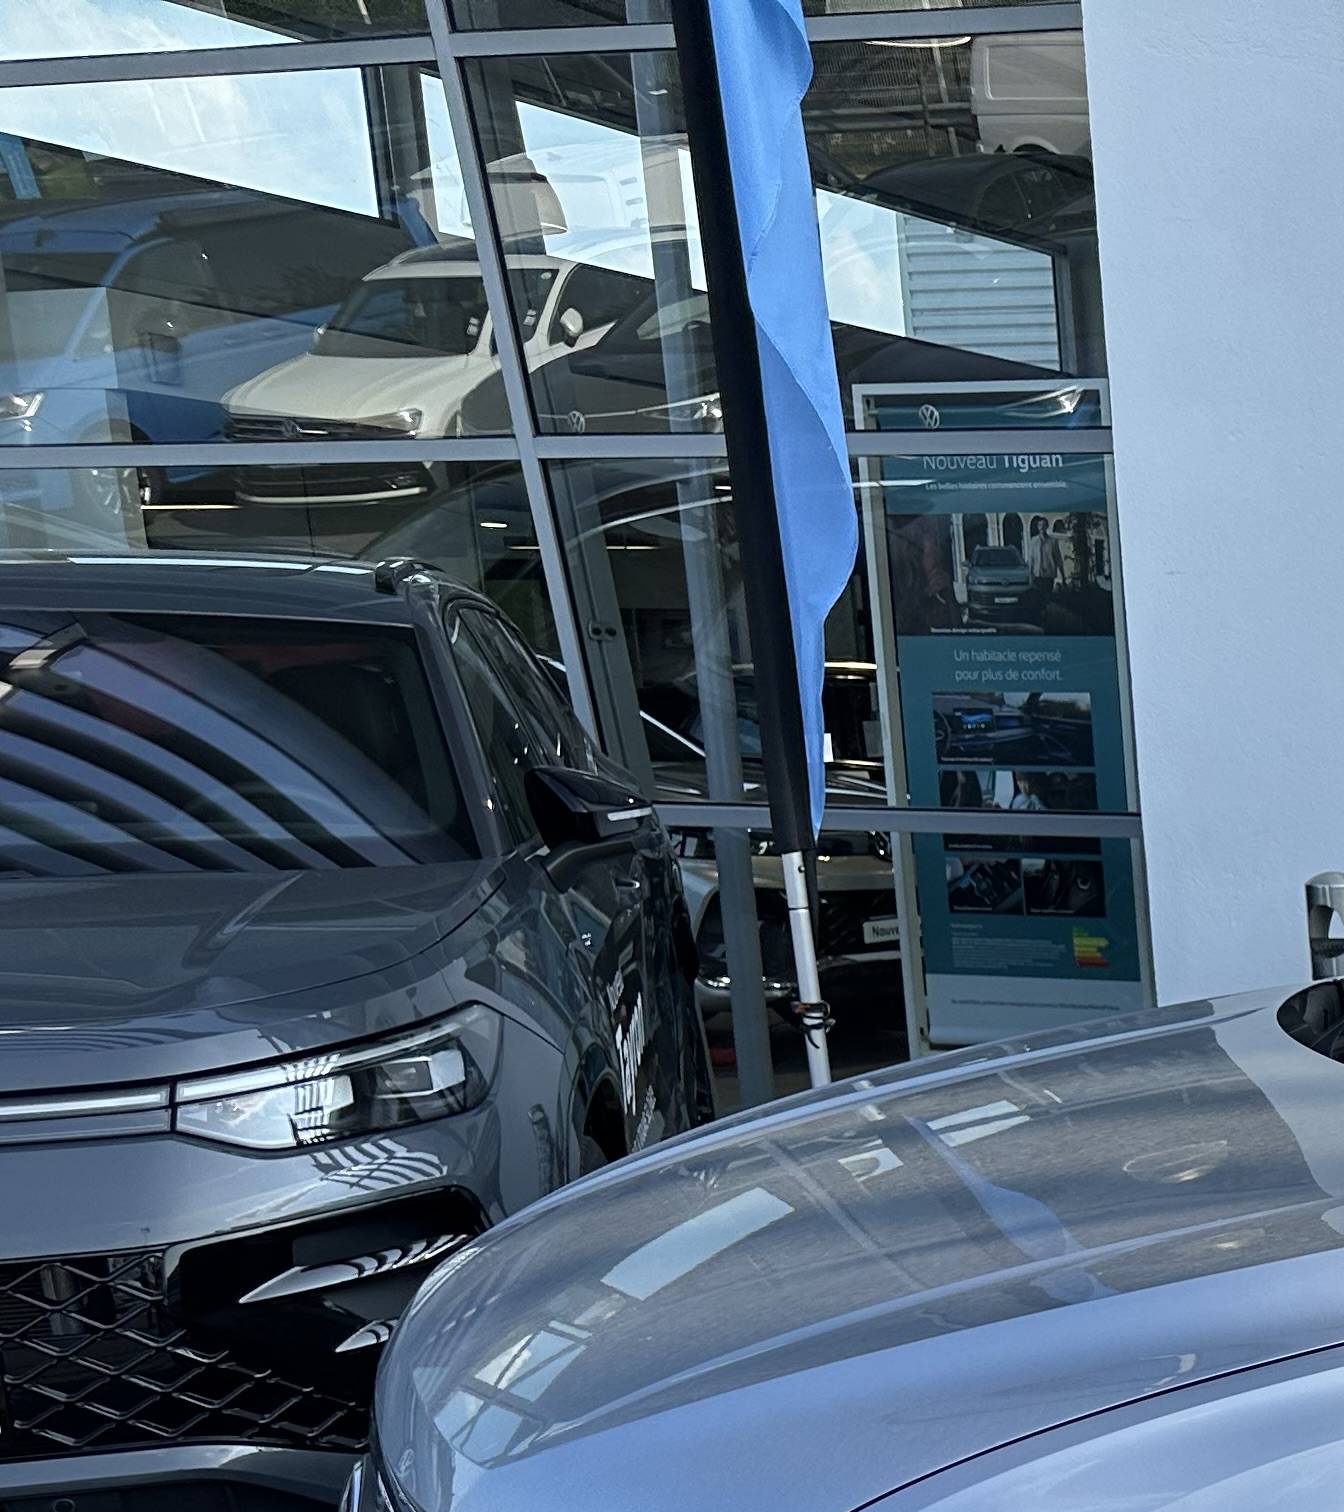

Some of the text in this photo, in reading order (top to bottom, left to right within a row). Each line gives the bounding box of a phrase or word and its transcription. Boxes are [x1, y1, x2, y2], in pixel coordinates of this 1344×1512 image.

[923, 455, 997, 471] Nouveau
[953, 648, 1062, 663] Un habitacle repensé
[955, 670, 978, 683] pour
[981, 668, 1003, 683] plus
[1004, 667, 1019, 681] de
